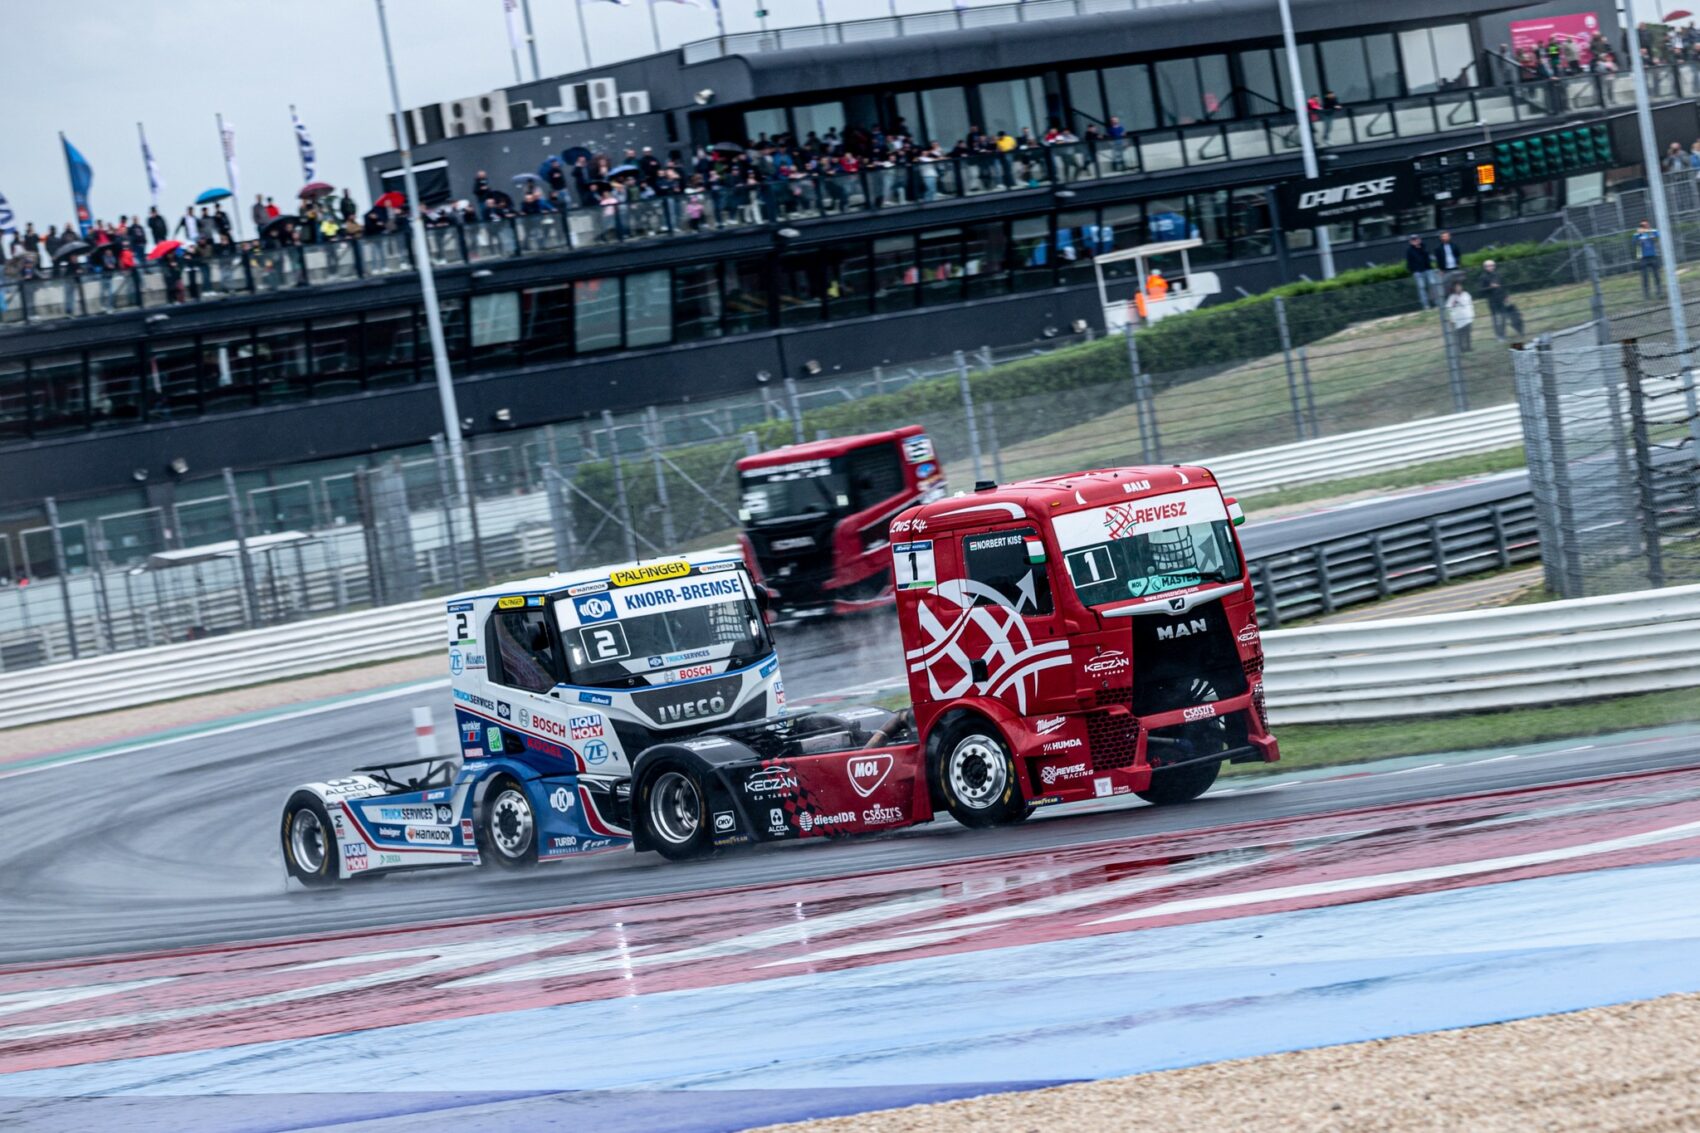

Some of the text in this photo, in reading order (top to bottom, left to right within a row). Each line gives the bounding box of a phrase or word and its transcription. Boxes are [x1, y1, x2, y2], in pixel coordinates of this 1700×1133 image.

[1122, 480, 1151, 493] BALU
[1136, 501, 1187, 523] REVESZ
[976, 535, 1022, 550] NORBERT KISS
[616, 562, 686, 583] PALFINGER
[908, 552, 918, 581] 1
[1084, 551, 1100, 581] 1
[624, 578, 741, 611] KNORR-BREMSE
[456, 613, 468, 639] 2
[1156, 618, 1207, 640] MAN
[594, 630, 618, 657] 2
[680, 665, 712, 680] BOSCH
[658, 696, 725, 722] IVECO
[533, 715, 566, 738] BOSCH
[570, 715, 600, 728] LIQUI
[572, 726, 602, 739] MOLY
[1052, 738, 1082, 751] HUMDA
[854, 761, 878, 778] MOL
[1056, 763, 1085, 775] REVESZ
[1064, 769, 1093, 780] RACING
[325, 783, 379, 796] ALCOA
[813, 812, 857, 826] dieselDR
[768, 825, 790, 833] ALCOA
[554, 836, 577, 847] TURBO
